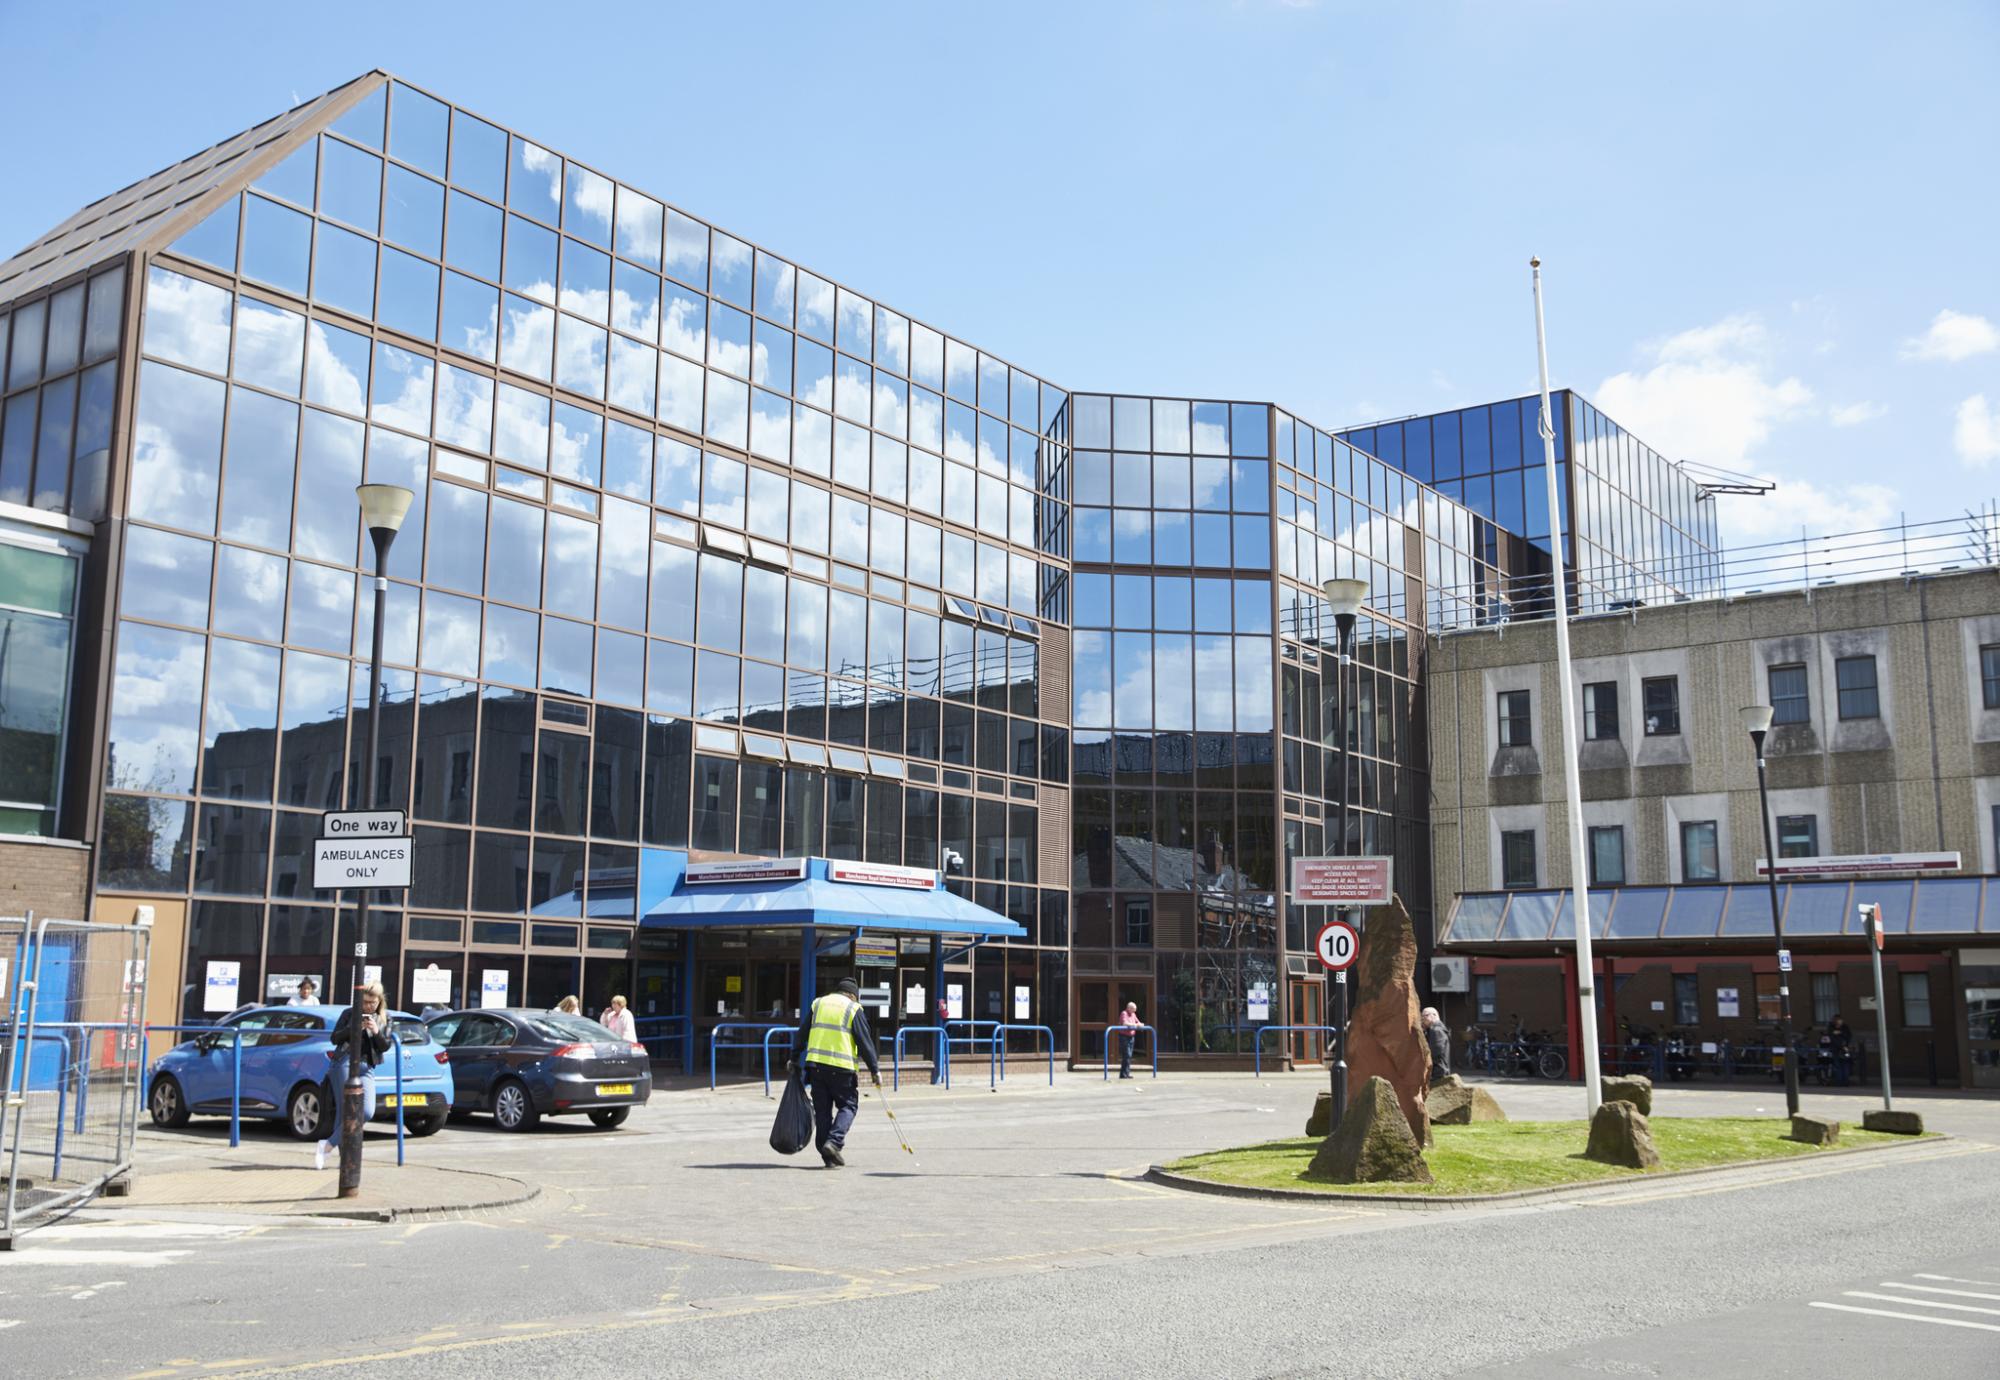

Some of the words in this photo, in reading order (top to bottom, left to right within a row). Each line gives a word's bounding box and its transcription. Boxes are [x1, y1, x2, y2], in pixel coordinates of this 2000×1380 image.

[330, 819, 360, 832] One
[367, 820, 398, 833] way
[320, 849, 405, 861] AMBULANCES
[346, 867, 378, 878] ONLY
[735, 871, 754, 879] Infirmary
[845, 872, 868, 880] Manchester
[879, 876, 896, 884] Infirmary
[1324, 935, 1349, 957] 10
